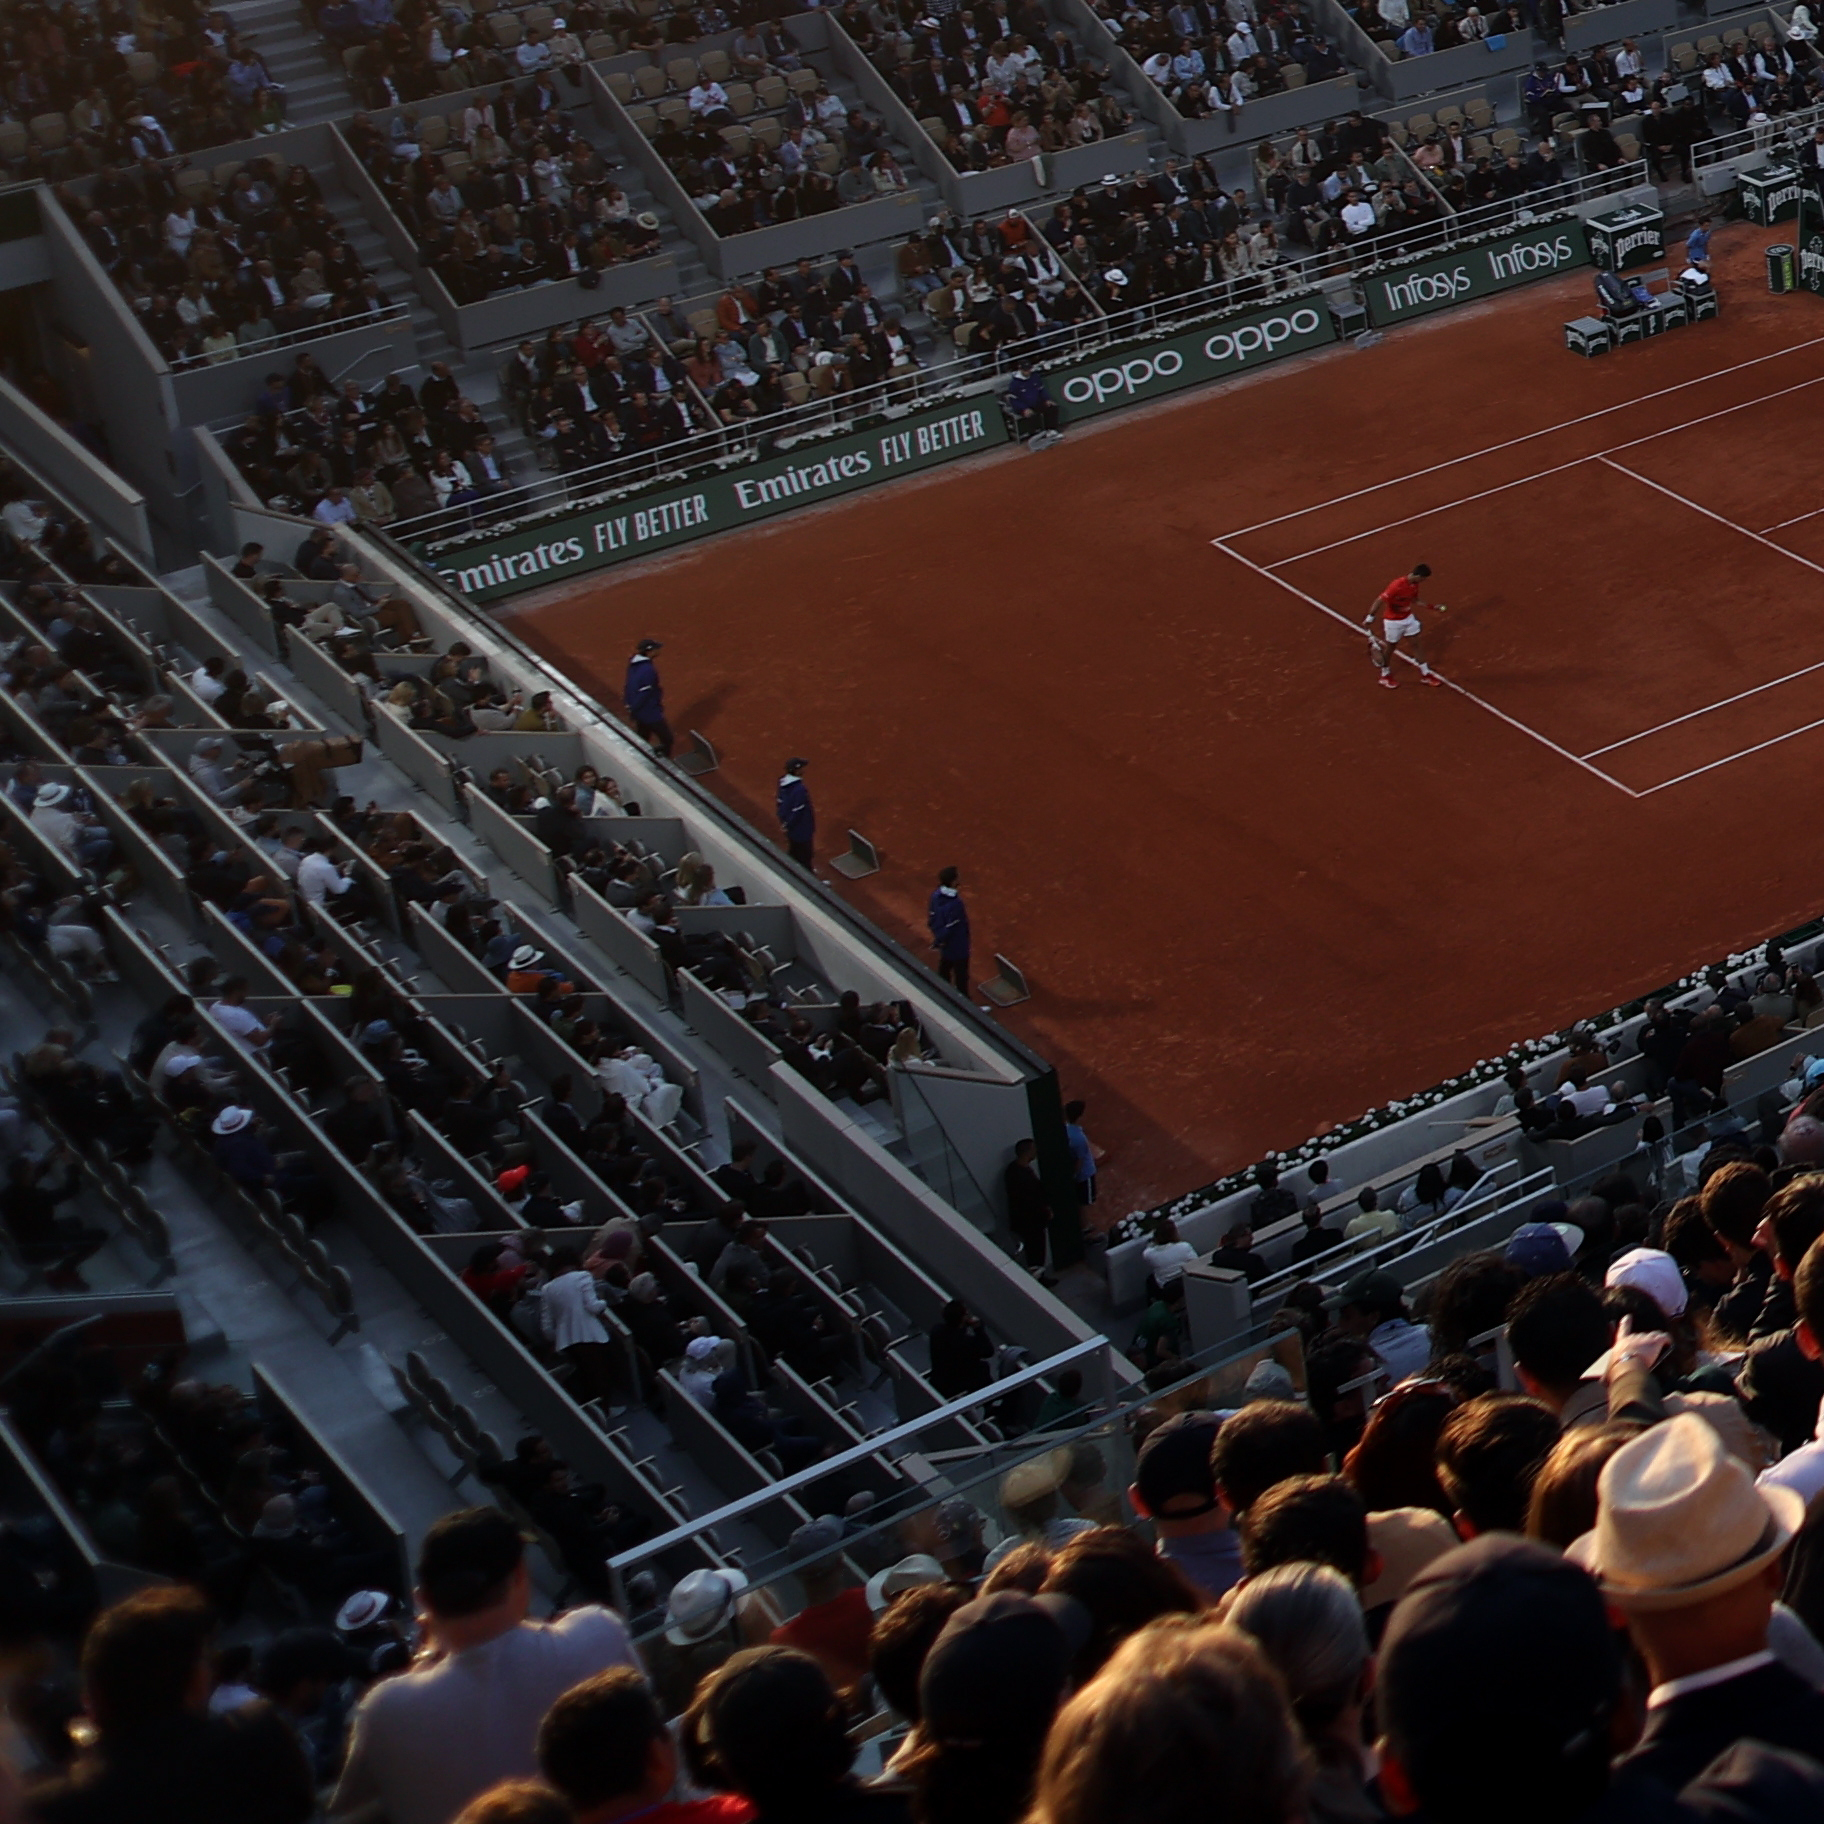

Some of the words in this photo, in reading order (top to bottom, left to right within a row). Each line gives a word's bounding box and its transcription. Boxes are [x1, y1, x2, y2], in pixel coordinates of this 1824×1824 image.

[1383, 266, 1471, 312] Infosys
[1487, 233, 1573, 280] Infosys
[1063, 350, 1183, 404] oppo
[1205, 309, 1320, 363] oppo
[733, 450, 871, 511] Emirates
[880, 432, 912, 468] FLY
[917, 410, 985, 455] BETTER
[594, 518, 628, 554] FLY
[634, 494, 709, 541] BETTER
